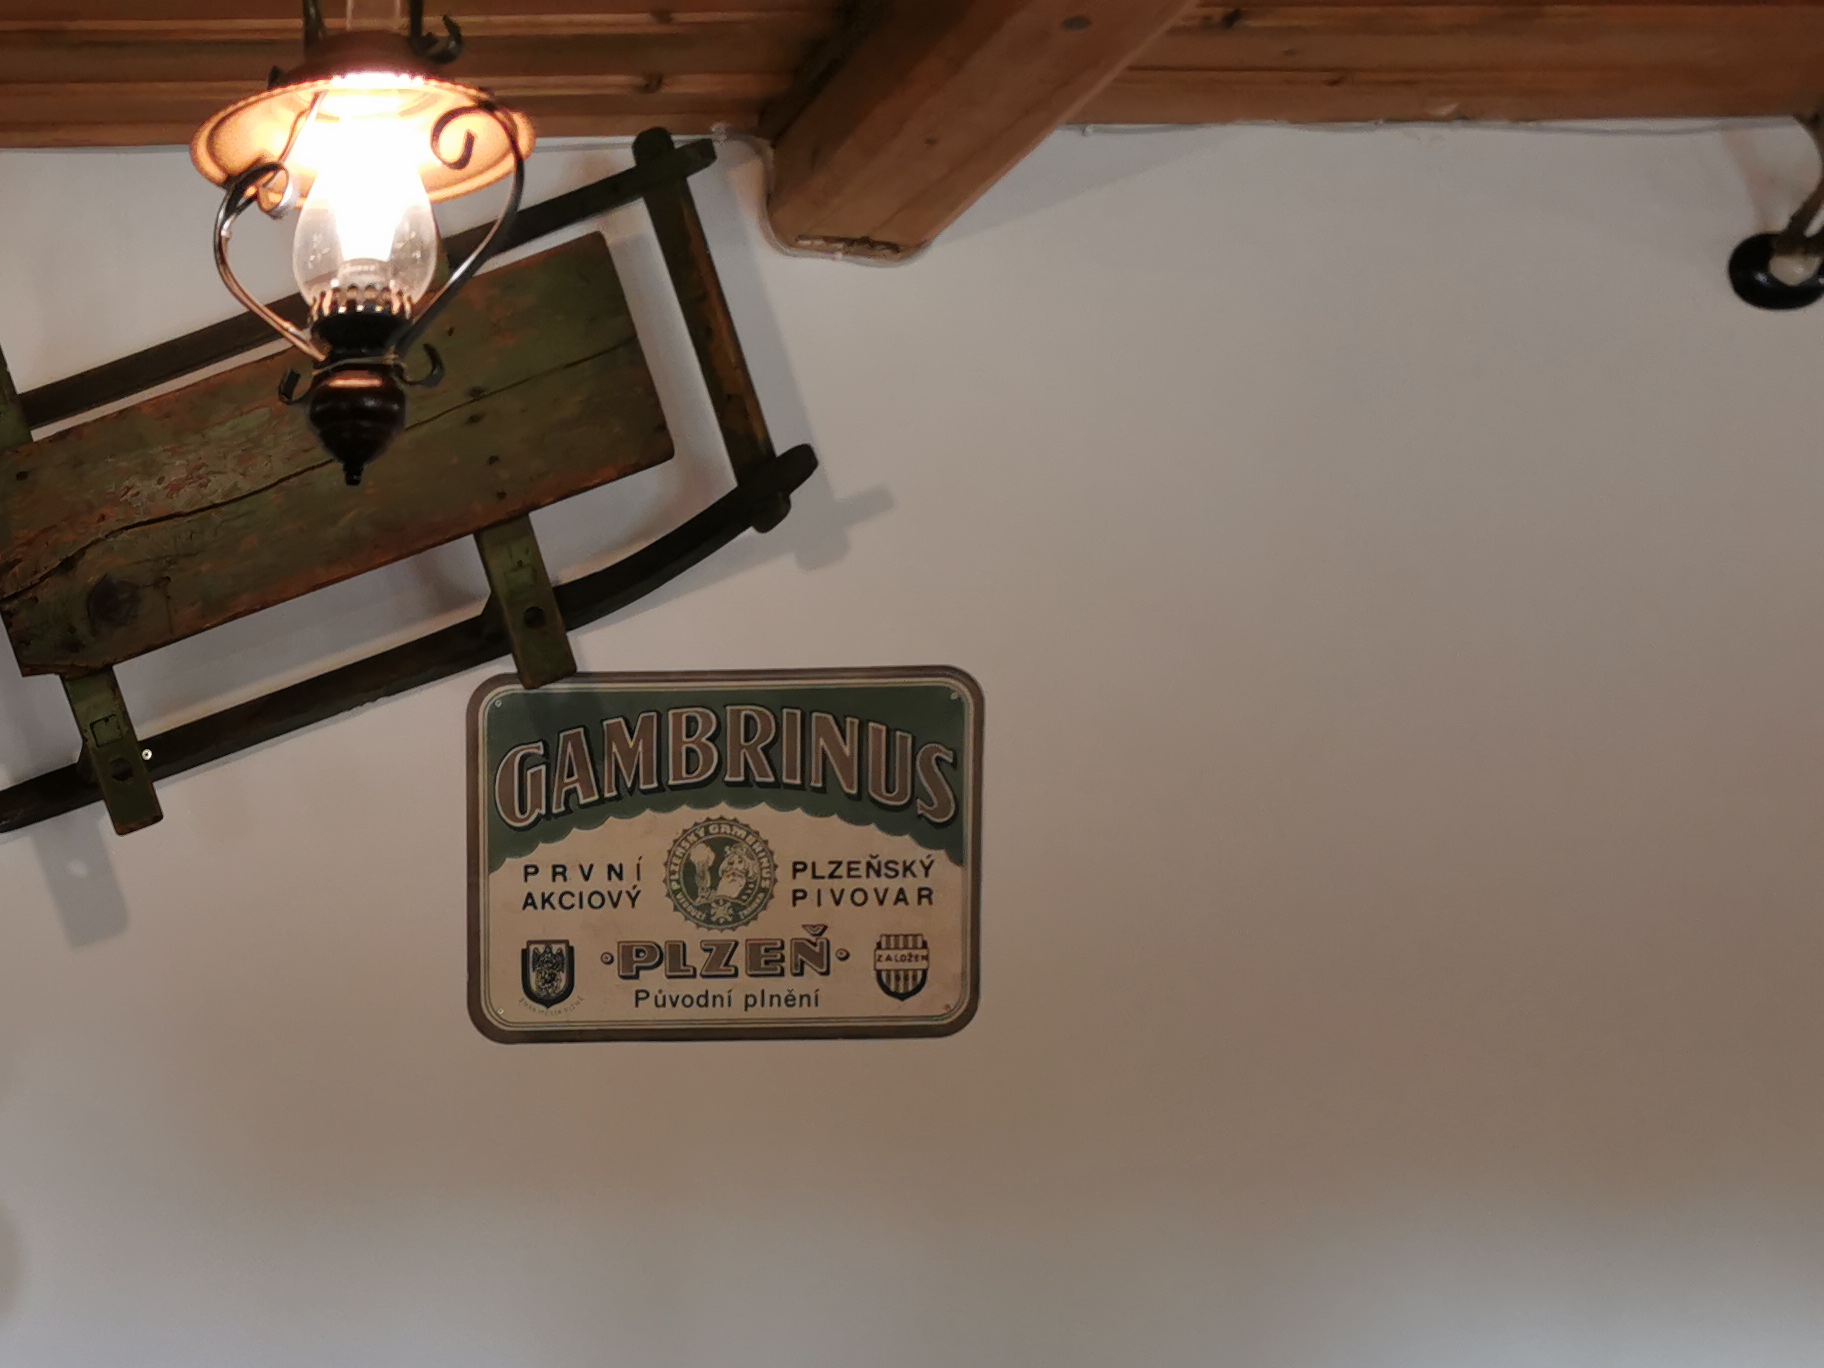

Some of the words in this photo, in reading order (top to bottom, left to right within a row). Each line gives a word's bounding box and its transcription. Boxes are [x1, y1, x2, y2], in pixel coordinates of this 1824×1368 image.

[493, 703, 959, 831] GAMBRINUS
[523, 856, 643, 883] PRVNÍ
[791, 854, 936, 881] PLZEŇSKÝ
[521, 884, 642, 912] AKCIOVÝ
[791, 886, 935, 908] PIVOVAR
[616, 924, 832, 980] PLZEŇ
[633, 988, 734, 1010] Původní
[743, 988, 820, 1012] plnění
